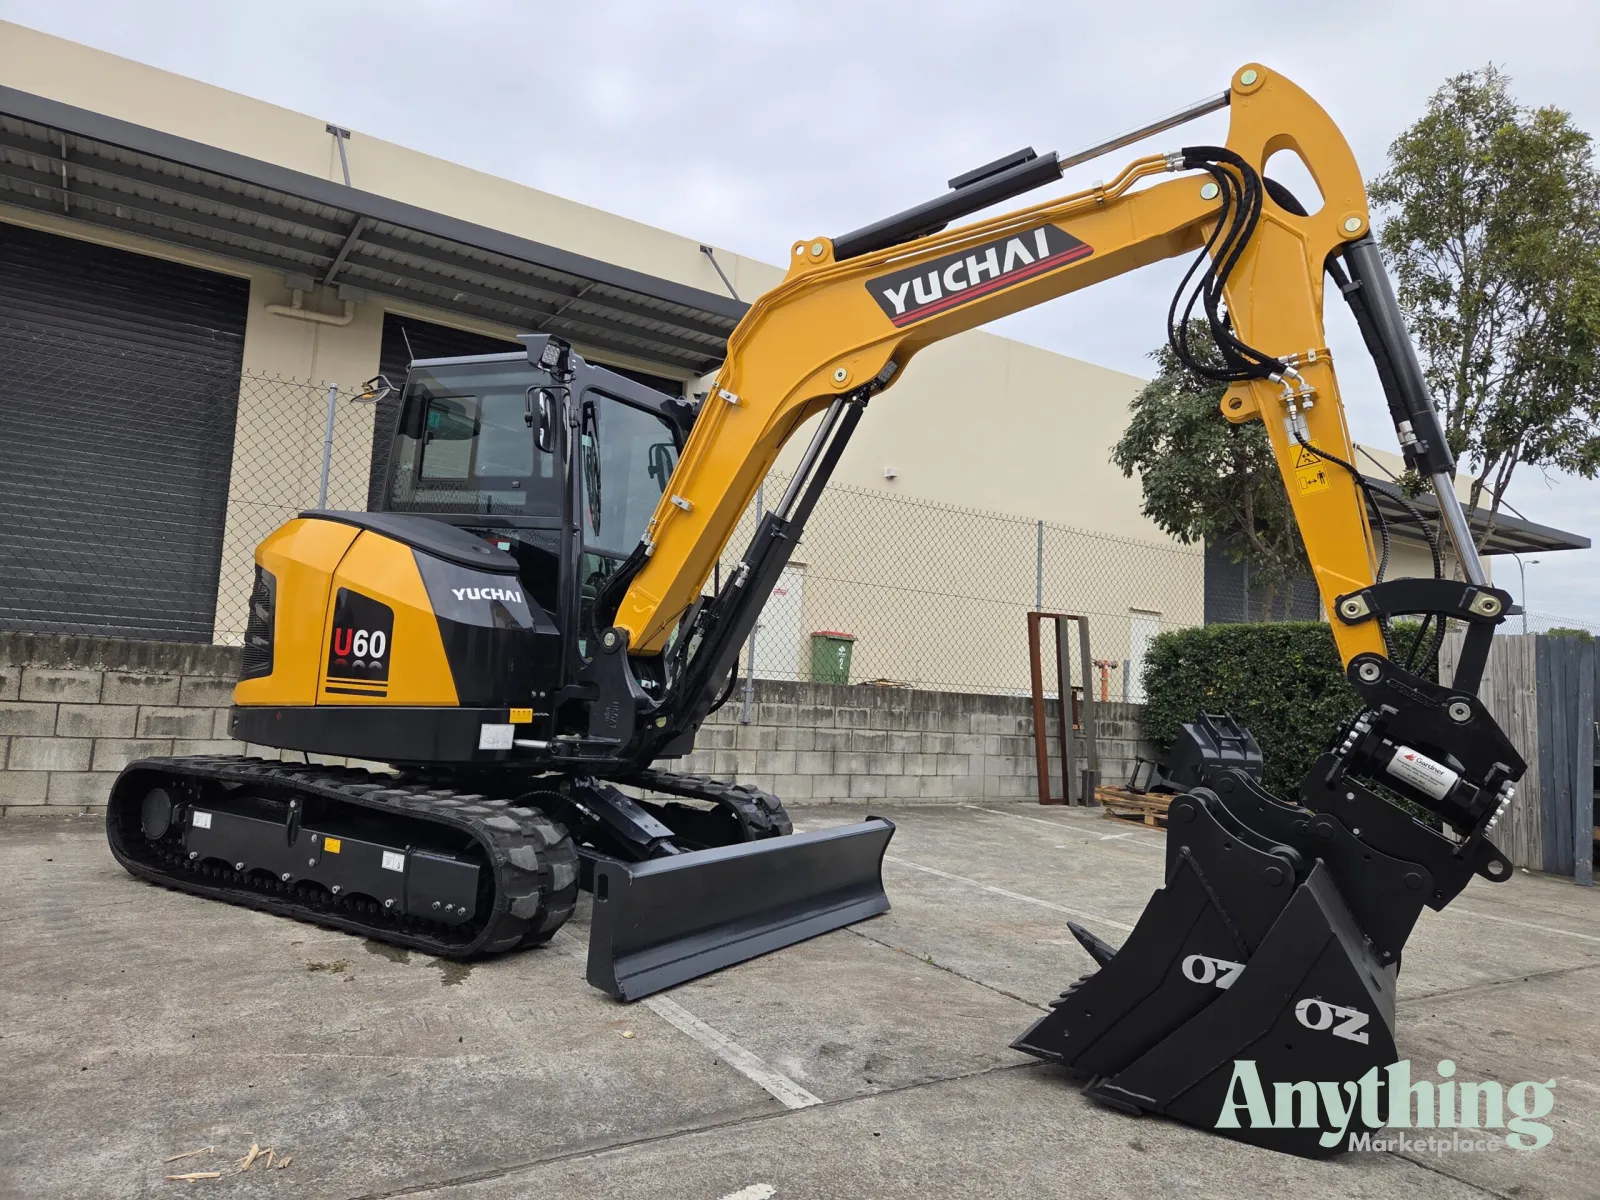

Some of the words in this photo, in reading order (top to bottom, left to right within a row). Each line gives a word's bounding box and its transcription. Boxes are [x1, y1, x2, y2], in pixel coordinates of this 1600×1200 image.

[883, 227, 1050, 314] YUCHAI
[452, 587, 522, 603] YUCHAI
[334, 628, 386, 659] U60
[1416, 757, 1445, 776] Gardner
[1295, 998, 1369, 1045] OZ
